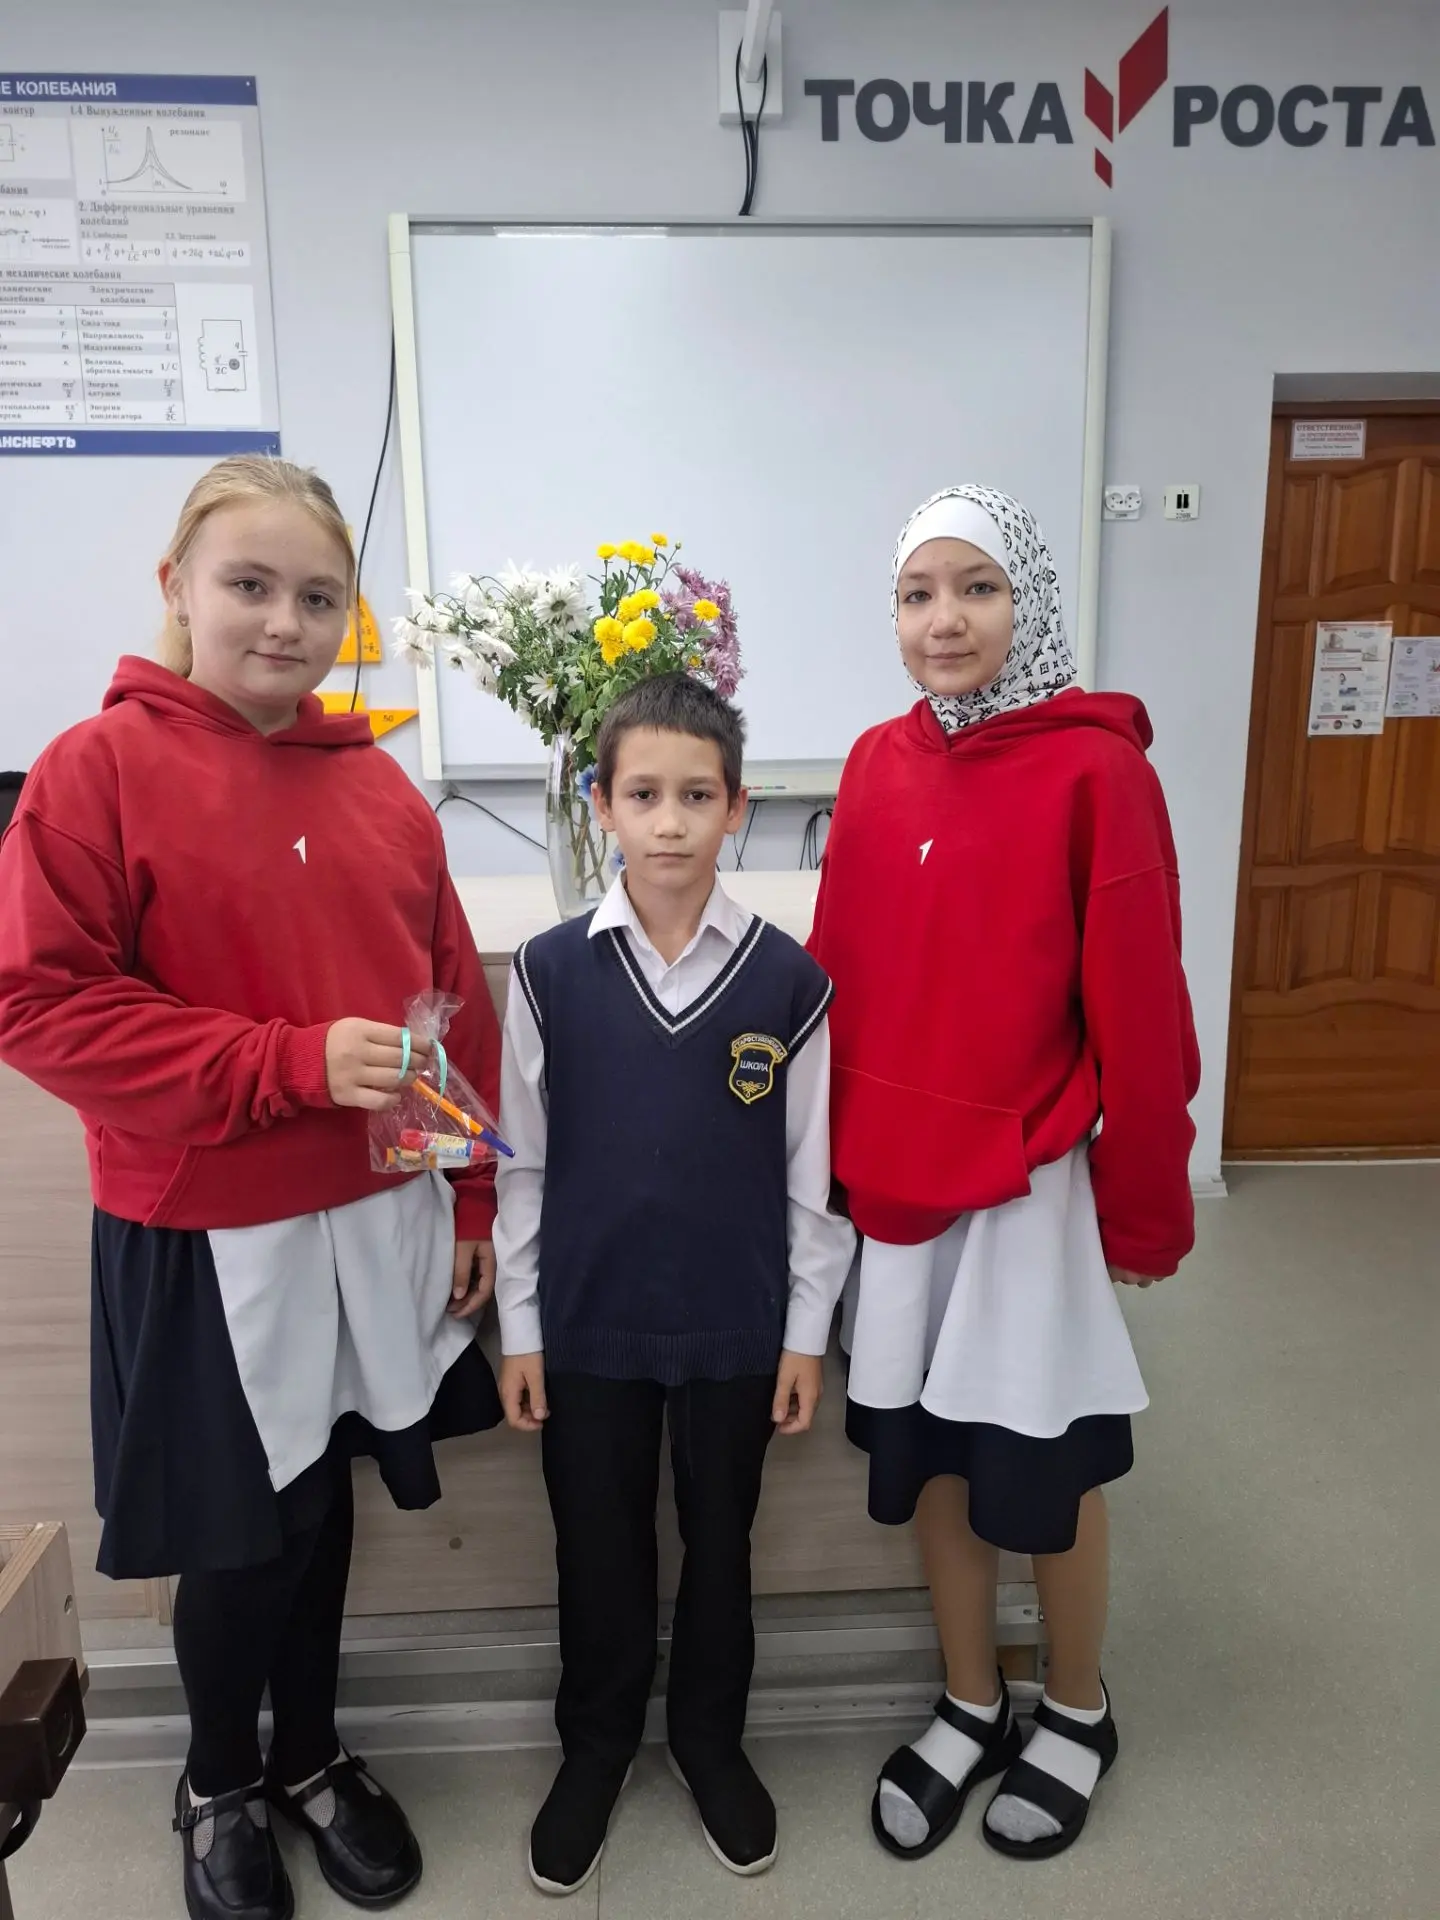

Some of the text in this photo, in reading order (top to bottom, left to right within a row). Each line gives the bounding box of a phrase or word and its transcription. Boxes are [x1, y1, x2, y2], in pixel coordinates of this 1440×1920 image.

[16, 81, 117, 96] КОЛЕБАНИЯ
[2, 106, 35, 118] контур
[86, 106, 153, 118] Вынужденные
[156, 108, 206, 118] колебания
[804, 78, 1437, 148] ТОЧКА РОСТА
[186, 204, 235, 216] уравнения
[73, 269, 122, 279] колебания
[740, 1060, 768, 1072] ШКОЛА
